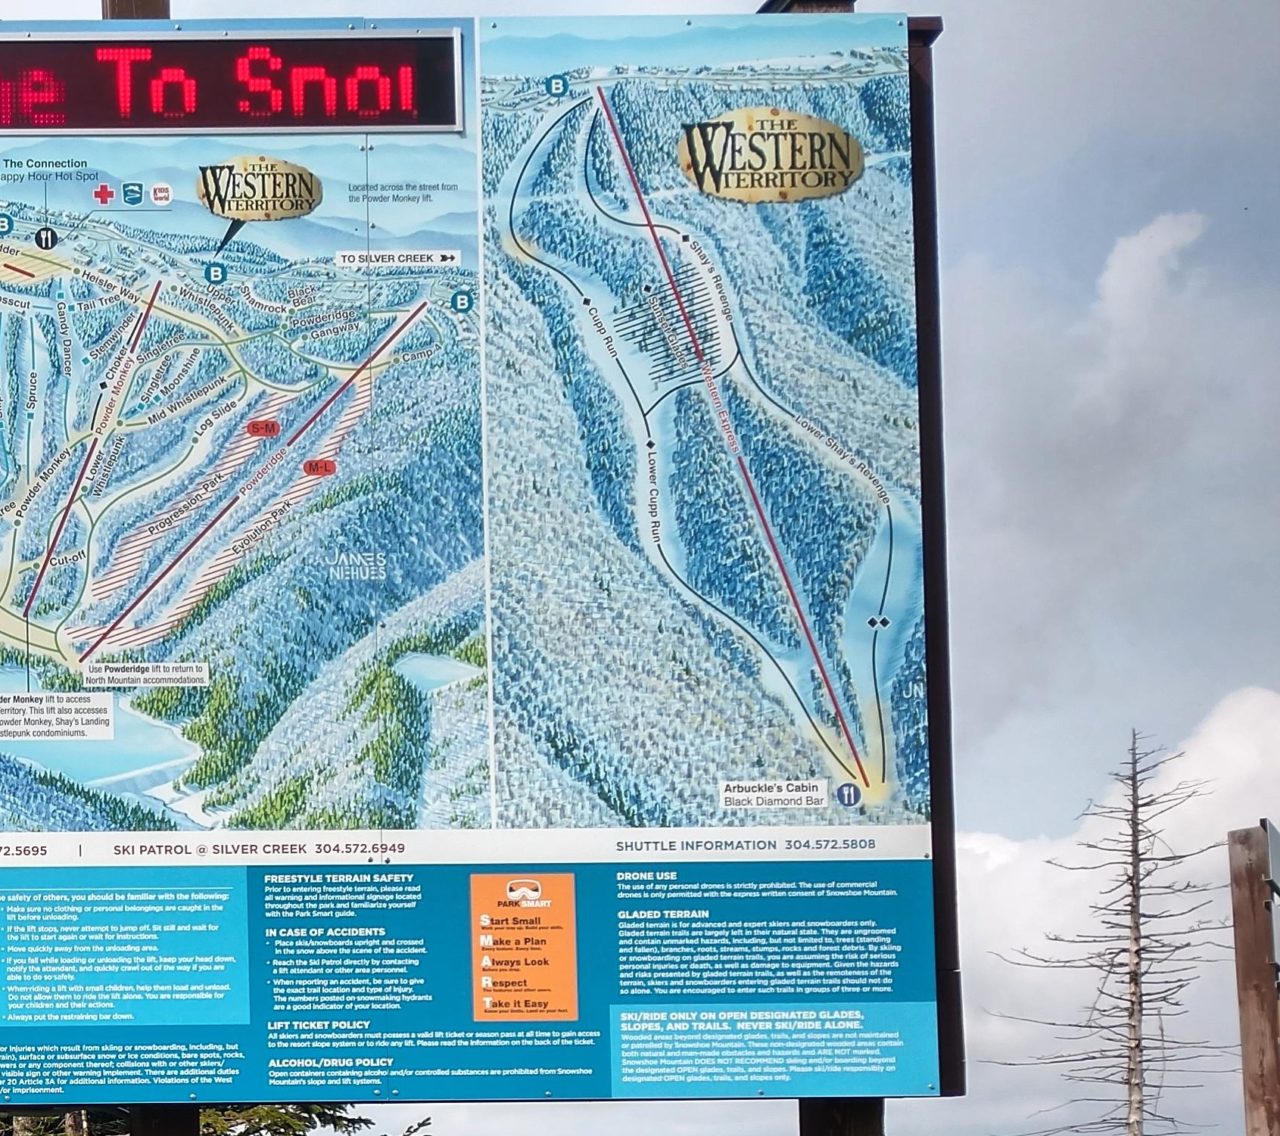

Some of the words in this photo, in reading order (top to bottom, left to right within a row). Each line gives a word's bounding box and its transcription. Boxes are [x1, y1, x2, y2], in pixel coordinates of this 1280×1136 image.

[96, 46, 197, 118] To
[236, 46, 418, 118] Sno
[756, 118, 798, 131] THE
[3, 159, 23, 168] The
[26, 159, 87, 168] Connection
[682, 121, 851, 193] WESTERN
[249, 161, 279, 172] THE
[721, 170, 853, 190] TERRITORY
[198, 164, 316, 215] WESTERN
[226, 199, 317, 213] TERRITORY
[341, 255, 355, 263] TO
[359, 252, 395, 265] SILVER
[398, 254, 433, 263] CREEK
[310, 322, 361, 341] Gangway
[588, 306, 606, 336] Cupp
[601, 334, 618, 359] Run
[251, 424, 276, 435] S-M
[308, 462, 332, 473] M-L
[48, 549, 87, 568] Cut-off
[724, 784, 783, 793] Arbuckle's
[786, 783, 818, 792] Cabin
[617, 841, 676, 851] SHUTTLE
[681, 841, 776, 850] INFORMATION
[786, 839, 875, 849] 304.572.5808
[616, 872, 655, 880] DRONE
[656, 872, 677, 880] USE
[497, 899, 520, 907] PARK
[480, 914, 509, 926] Start
[512, 917, 540, 925] Small
